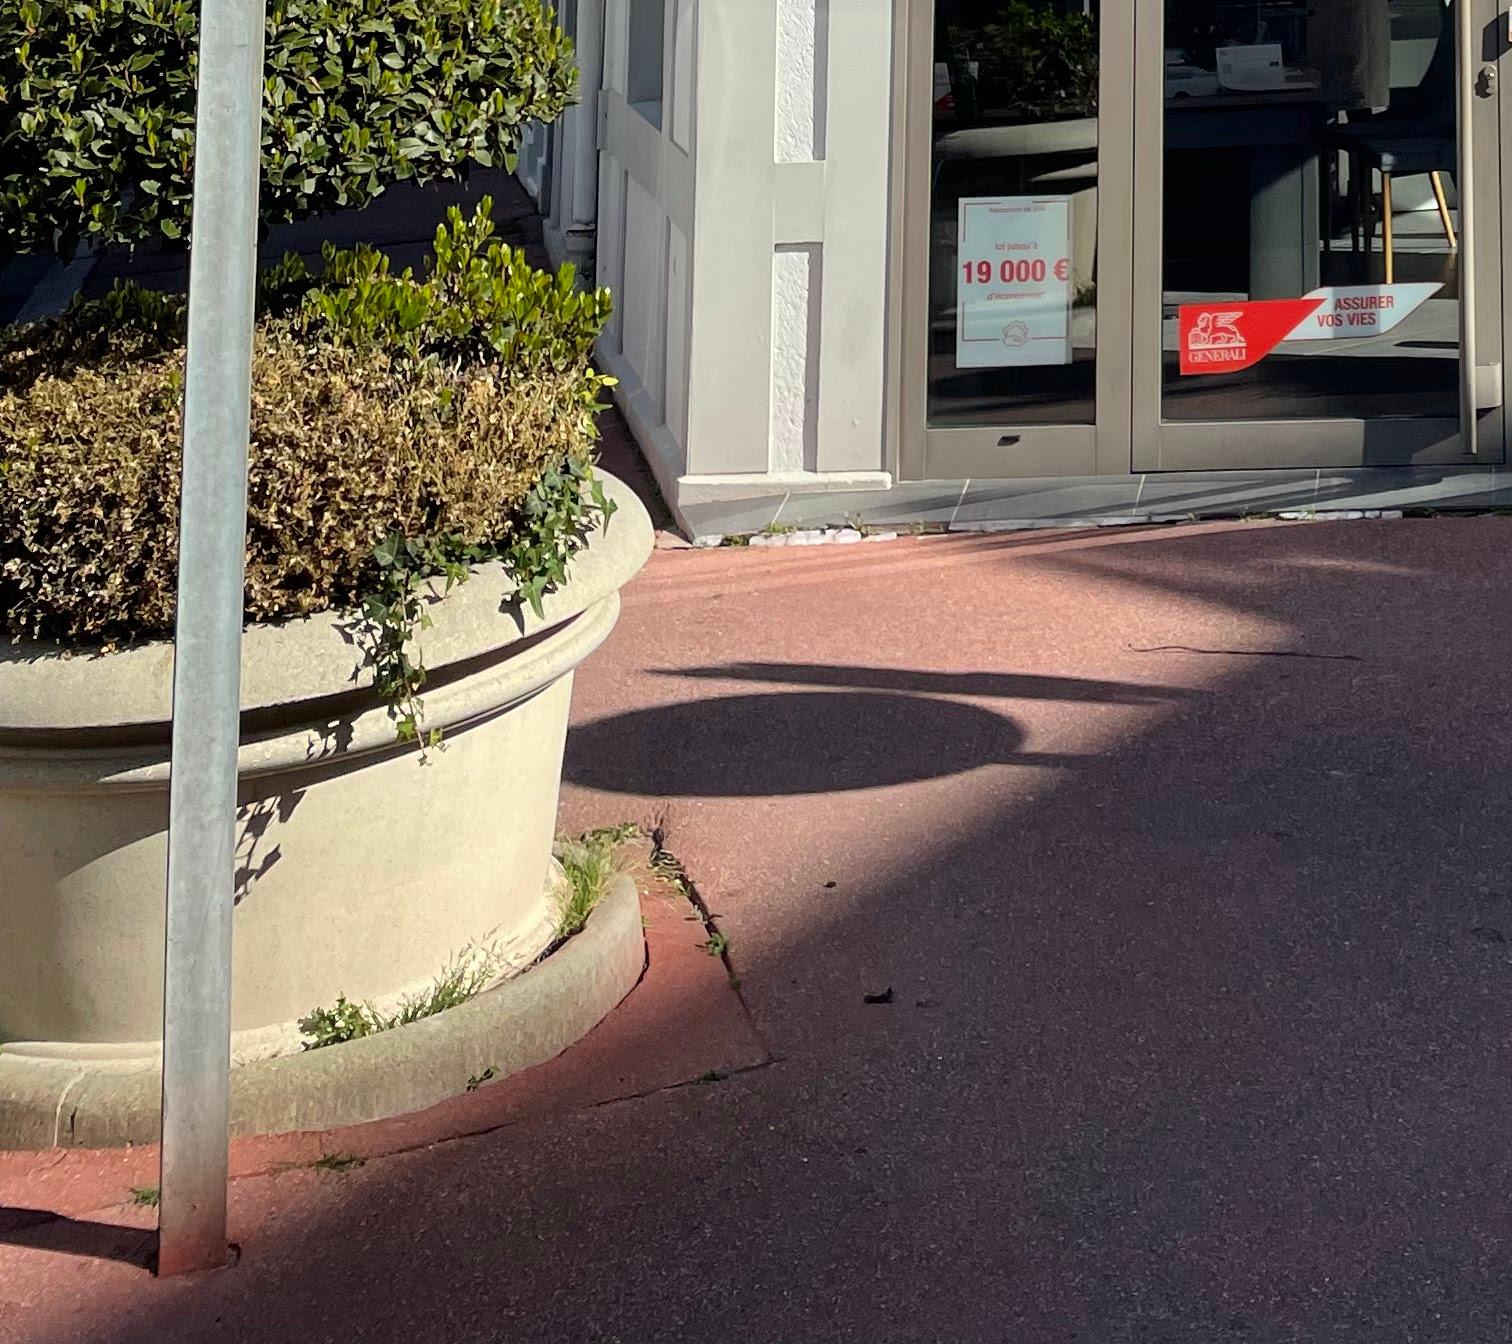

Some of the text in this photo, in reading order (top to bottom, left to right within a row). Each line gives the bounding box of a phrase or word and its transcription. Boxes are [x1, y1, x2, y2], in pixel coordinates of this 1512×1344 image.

[963, 258, 1069, 284] 19 000 €
[1334, 295, 1394, 310] ASSURER
[1317, 312, 1376, 327] VOS VIES
[1189, 349, 1246, 362] GENERALI
